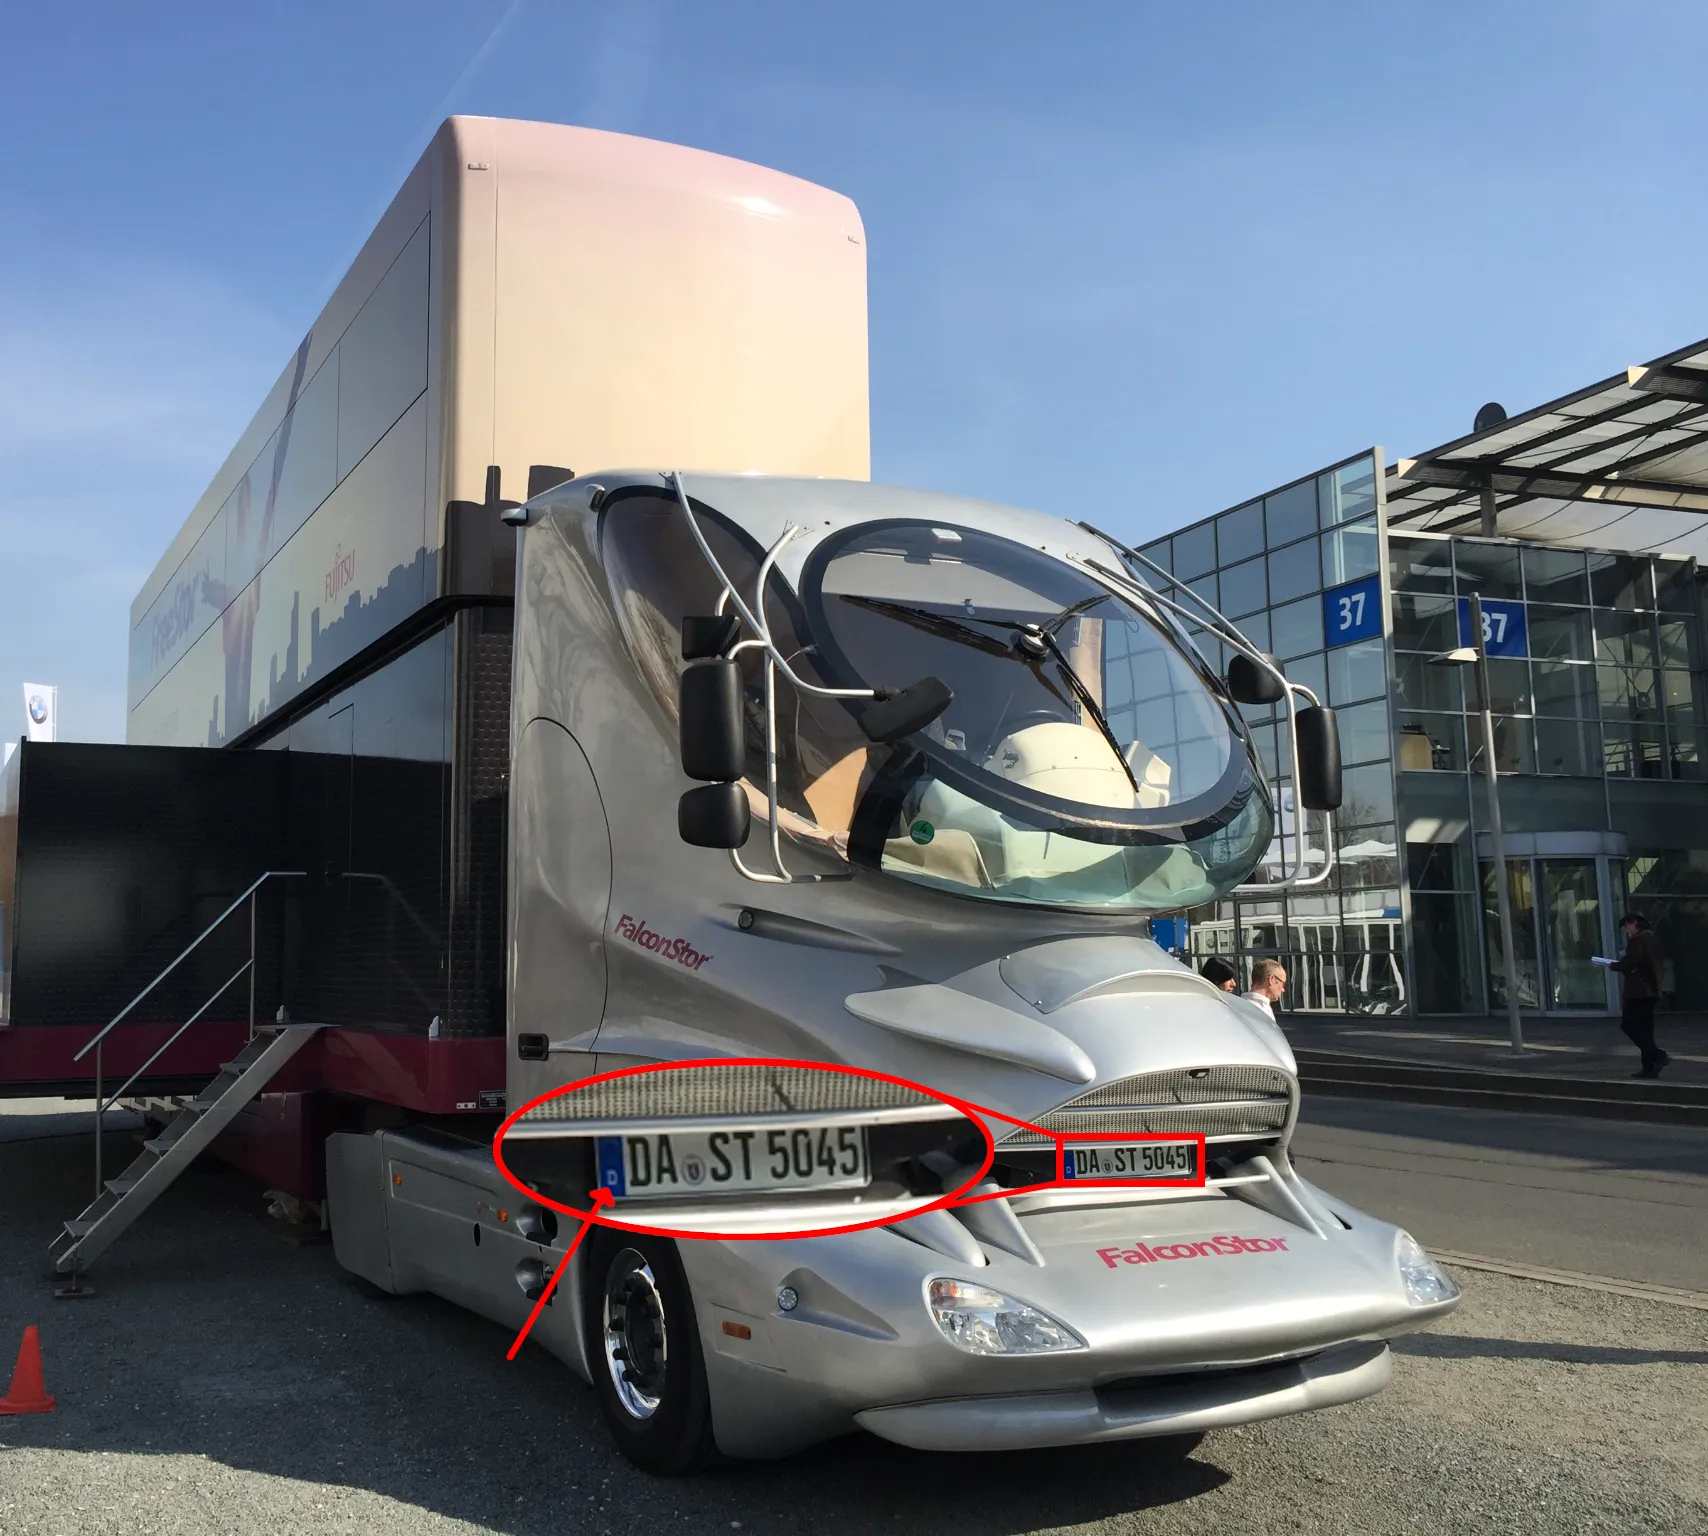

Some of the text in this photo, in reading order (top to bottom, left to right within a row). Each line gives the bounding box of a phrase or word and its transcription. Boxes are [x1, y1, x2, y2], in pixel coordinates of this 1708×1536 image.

[1338, 591, 1366, 631] 37
[1479, 611, 1508, 643] 37
[613, 913, 712, 971] FalconStor
[1065, 1145, 1187, 1175] D DA ST 5045
[1095, 1235, 1290, 1269] FalconStor
